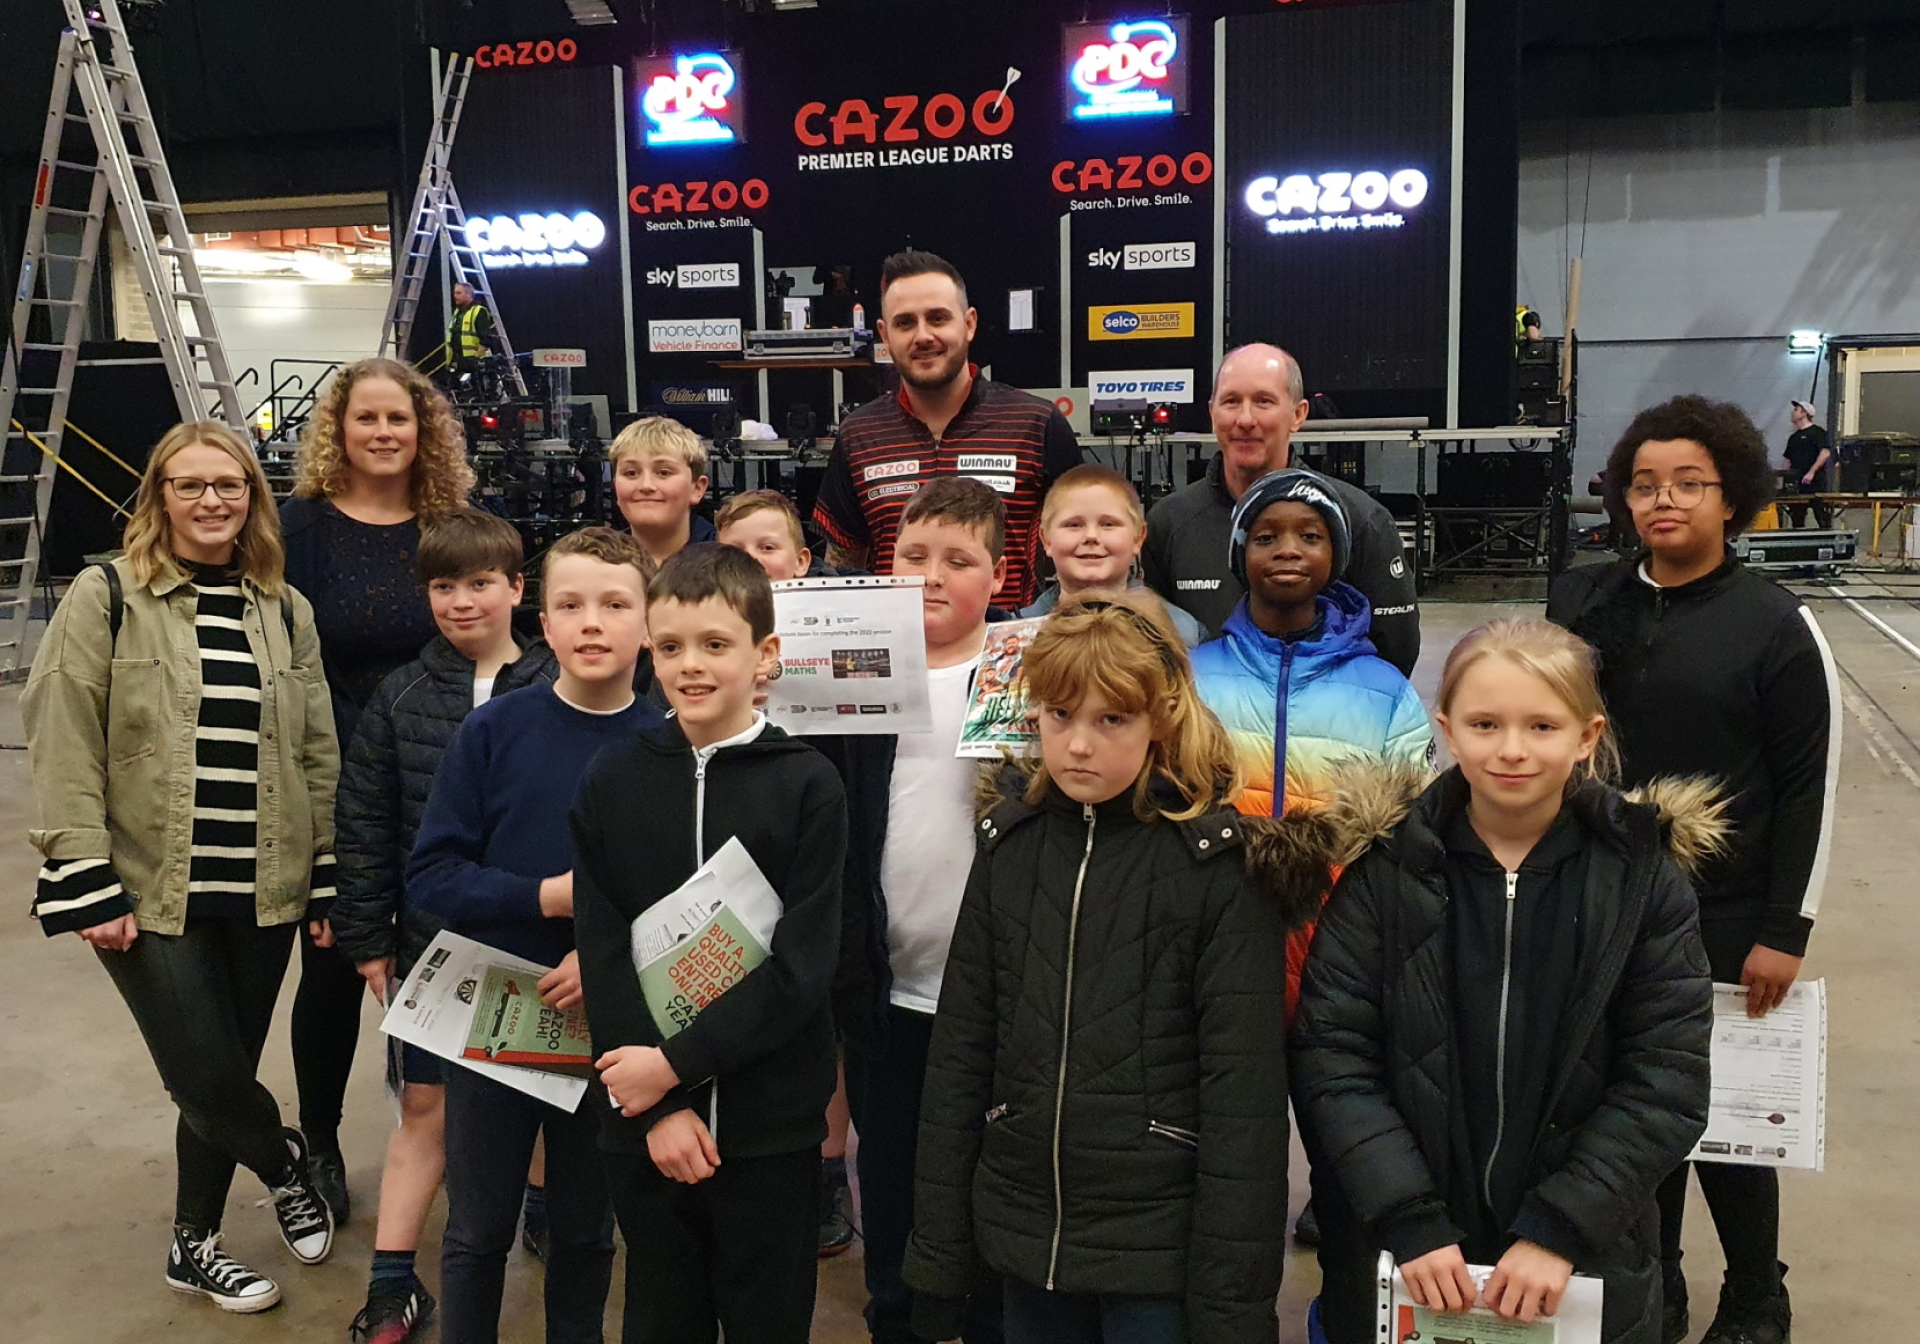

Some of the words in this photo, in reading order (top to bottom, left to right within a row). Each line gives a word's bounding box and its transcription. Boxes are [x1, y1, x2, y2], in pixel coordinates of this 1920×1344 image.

[475, 38, 577, 68] CAZOO
[1084, 40, 1169, 82] PDC
[652, 70, 729, 114] PDC
[794, 89, 1015, 146] CAZOO
[798, 151, 875, 171] PREMIER
[879, 146, 949, 167] LEAGUE
[953, 143, 1014, 162] DARTS
[1051, 152, 1213, 193] CAZOO
[629, 178, 769, 214] CAZOO
[1070, 198, 1115, 210] Search.
[1117, 196, 1152, 208] Drive.
[1154, 192, 1193, 206] Smile.
[1246, 169, 1428, 216] CAZOO
[464, 210, 606, 251] CAZOO
[646, 219, 686, 232] Search.
[687, 218, 718, 230] Drive.
[719, 216, 753, 228] Smile.
[1088, 247, 1122, 270] sky
[1128, 247, 1191, 267] sports
[646, 266, 676, 288] sky
[681, 267, 736, 286] sports
[652, 321, 738, 339] moneybarn
[1104, 315, 1138, 328] selco
[652, 340, 693, 351] Vehicle
[694, 340, 738, 350] Finance
[543, 353, 582, 363] CAZOO
[1140, 381, 1186, 392] TIRES
[866, 462, 917, 478] CAZOO
[960, 458, 1012, 468] WINMAU
[1176, 579, 1222, 590] WINMAU
[784, 658, 830, 667] BULLSEYE
[785, 666, 817, 675] MATHS
[707, 922, 736, 947] BUY
[731, 946, 745, 960] A
[687, 946, 722, 979] USED
[507, 1001, 522, 1035] CAZOO
